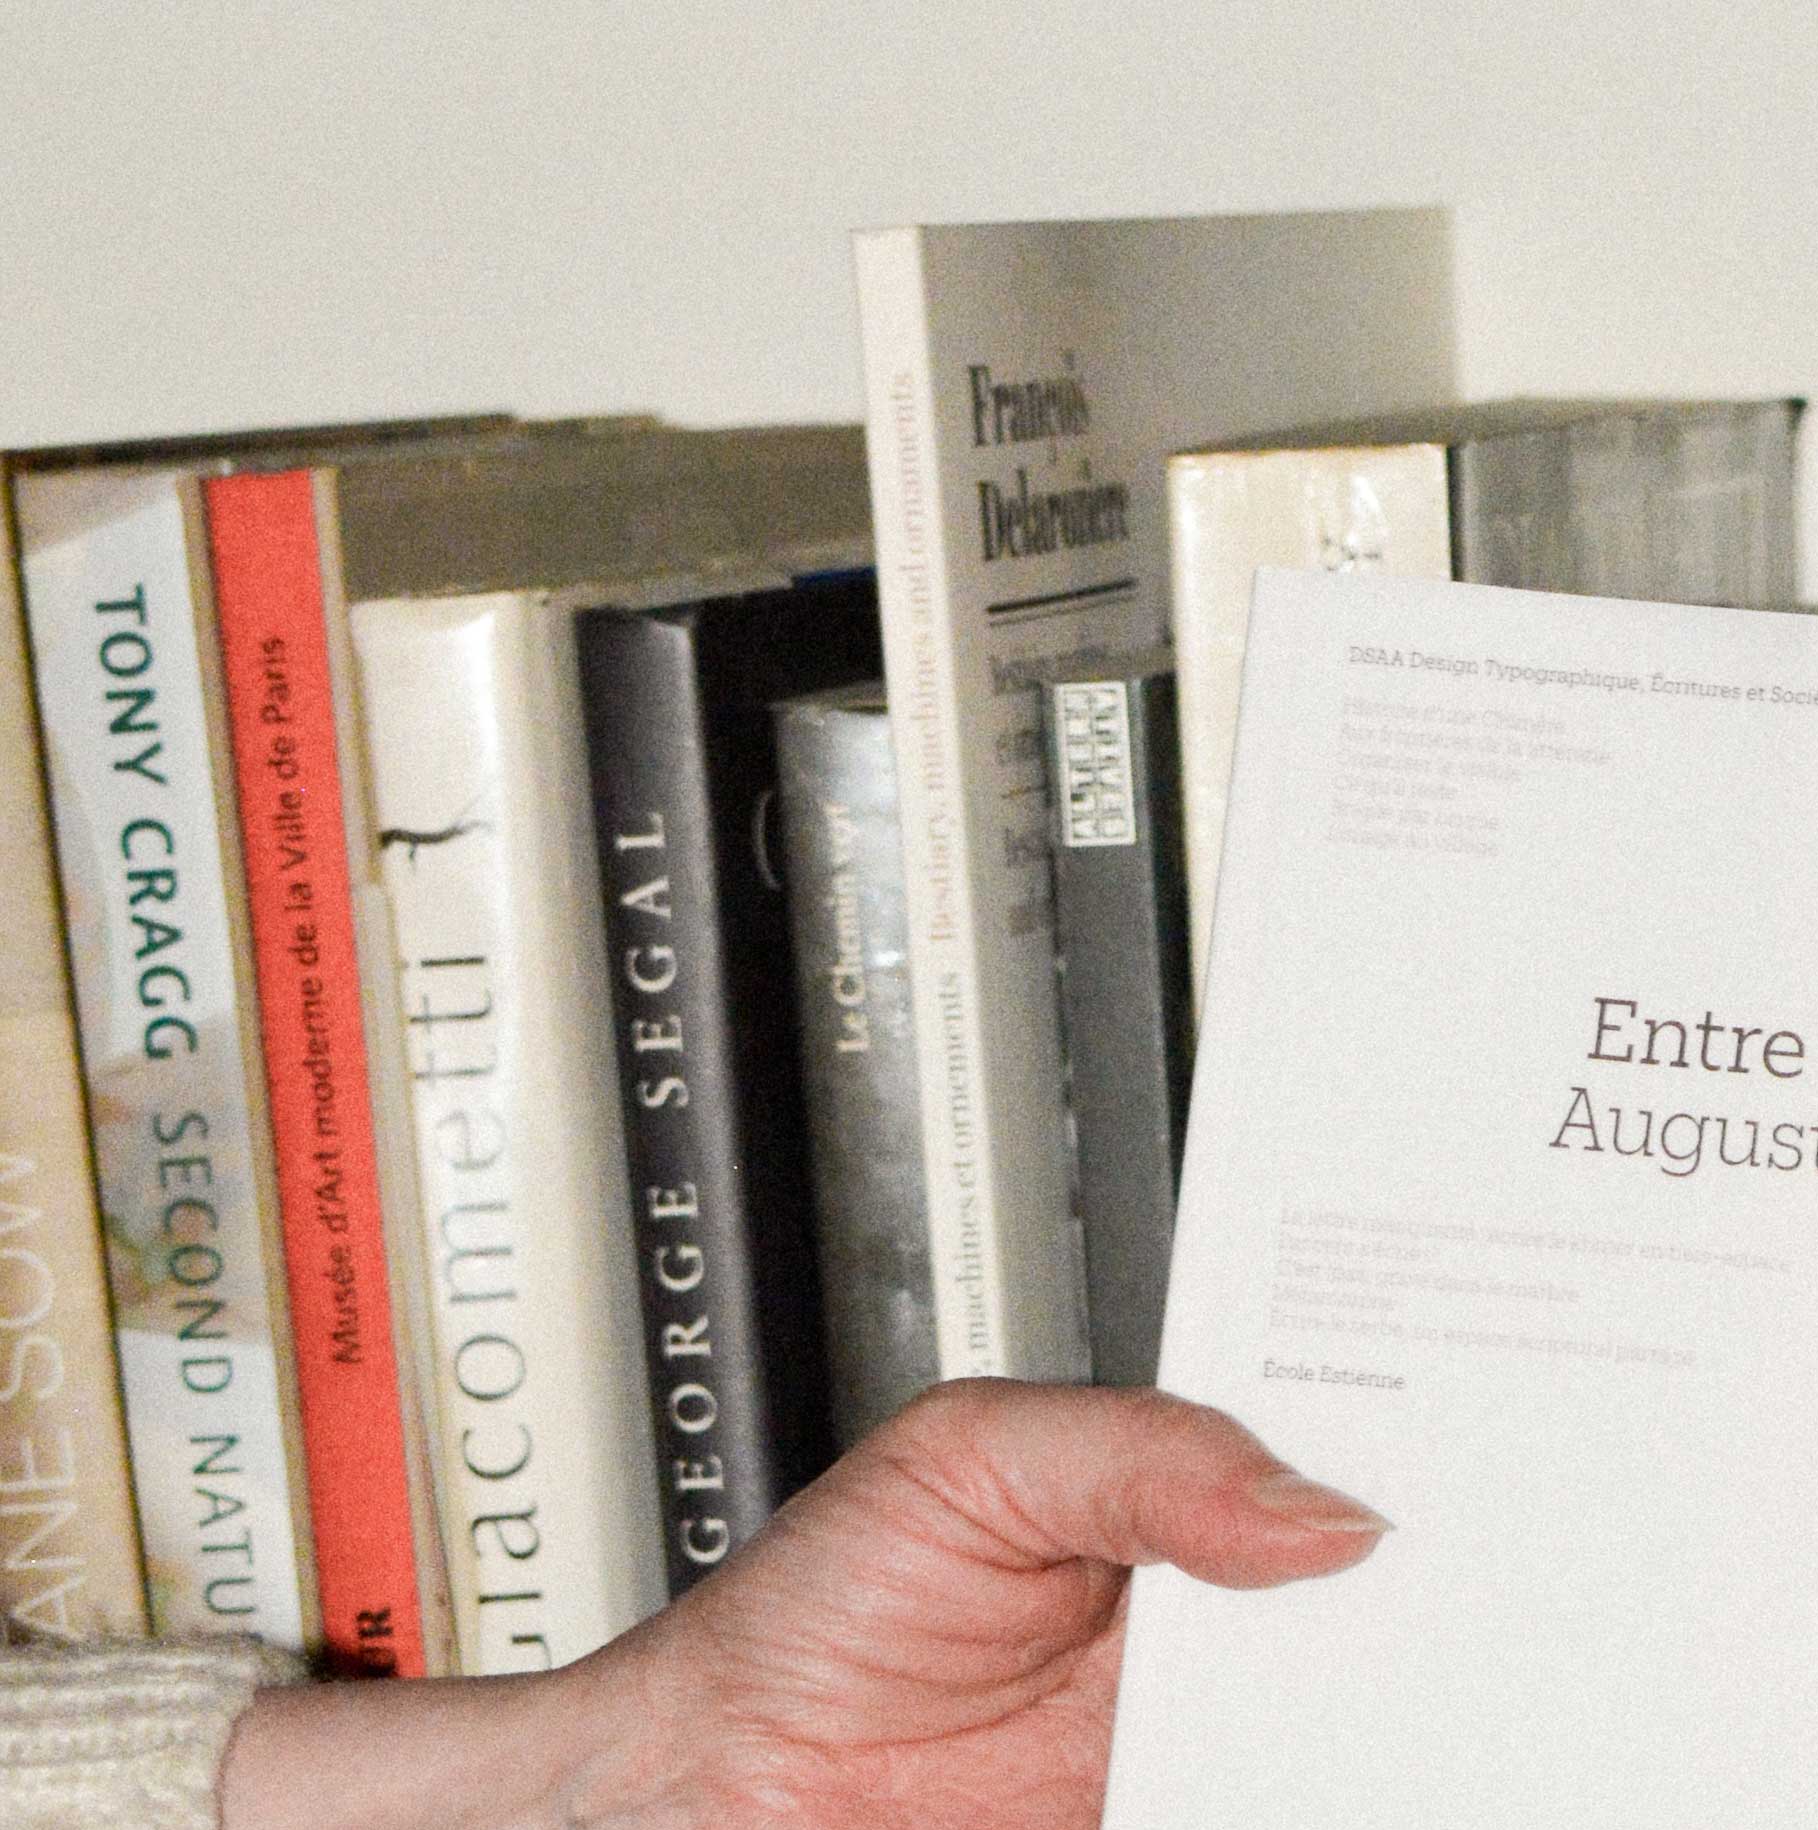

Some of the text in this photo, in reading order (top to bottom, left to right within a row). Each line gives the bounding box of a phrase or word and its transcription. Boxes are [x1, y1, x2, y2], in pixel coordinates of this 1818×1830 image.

[93, 583, 171, 788] TONY
[262, 637, 290, 722] Paris
[1349, 645, 1405, 669] DSAA
[1409, 651, 1479, 678] Design
[1483, 658, 1646, 695] Typographique,
[1650, 672, 1741, 701] Écritures
[1745, 683, 1767, 703] et
[270, 730, 300, 780] de
[278, 789, 312, 871] Ville
[121, 818, 197, 1061] CRAGG
[284, 885, 316, 918] la
[287, 920, 321, 967] de
[302, 975, 337, 1137] moderne
[1587, 997, 1805, 1079] Entre
[615, 813, 730, 1565] GEORGE SEGAL
[153, 1112, 232, 1394] SECOND
[329, 1246, 363, 1366] Musée
[1318, 1362, 1407, 1392] Estienne
